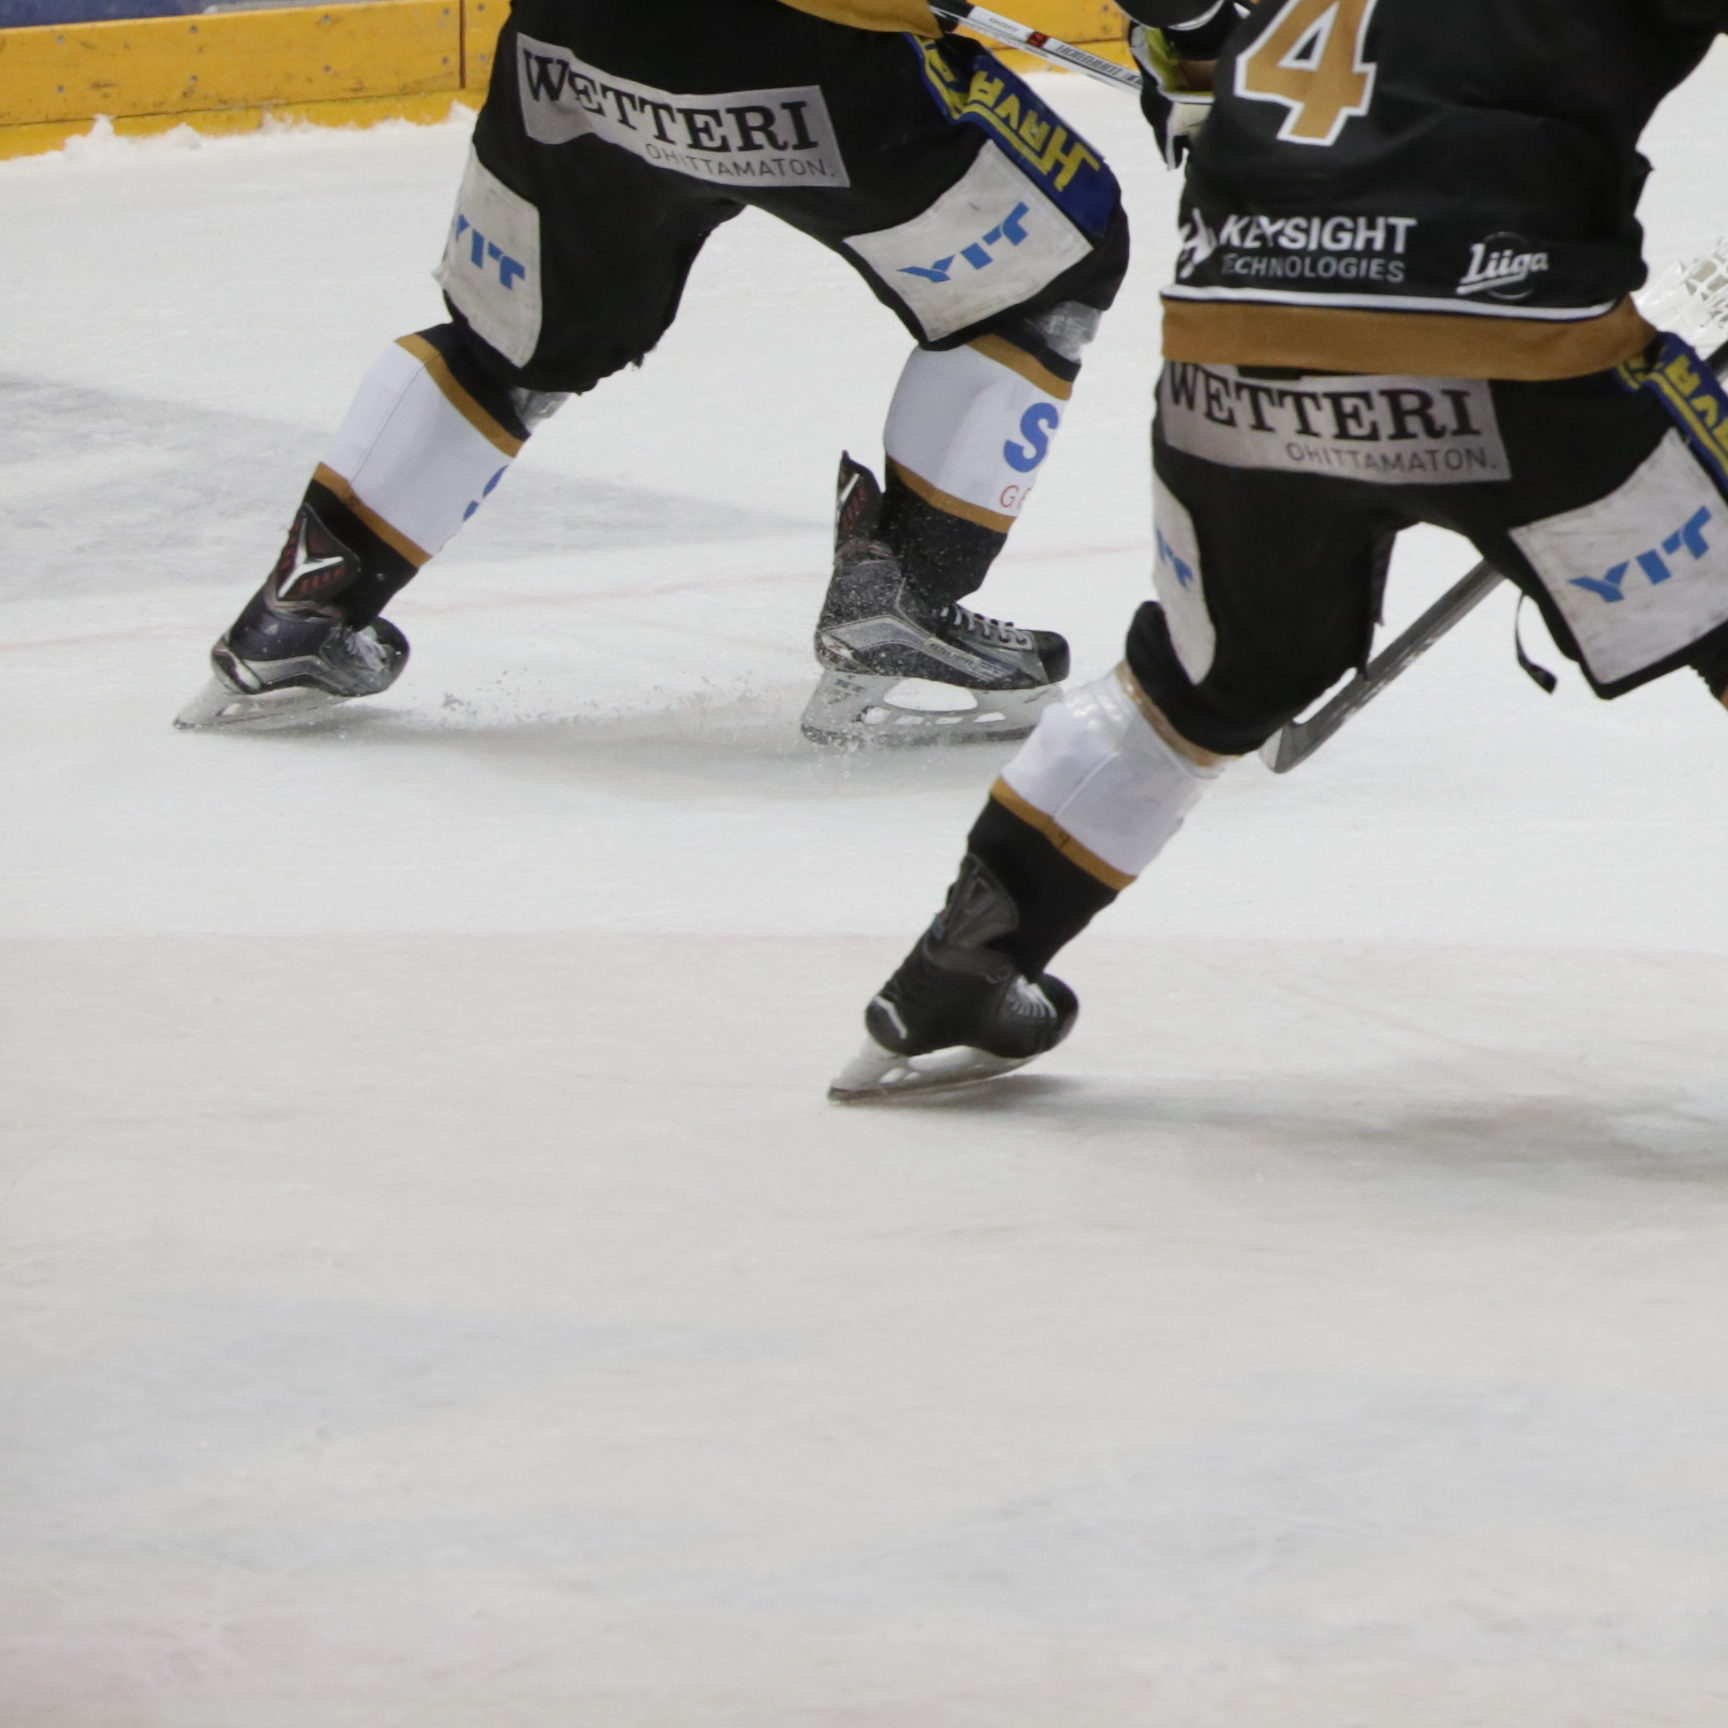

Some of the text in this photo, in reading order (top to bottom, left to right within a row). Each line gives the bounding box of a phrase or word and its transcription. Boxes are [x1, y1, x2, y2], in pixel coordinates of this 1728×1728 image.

[522, 44, 820, 153] WETTERI
[896, 200, 1030, 284] YIT
[1219, 214, 1418, 255] KEYSIGHT
[1166, 368, 1483, 441] WETTERI
[1569, 504, 1715, 605] YIT
